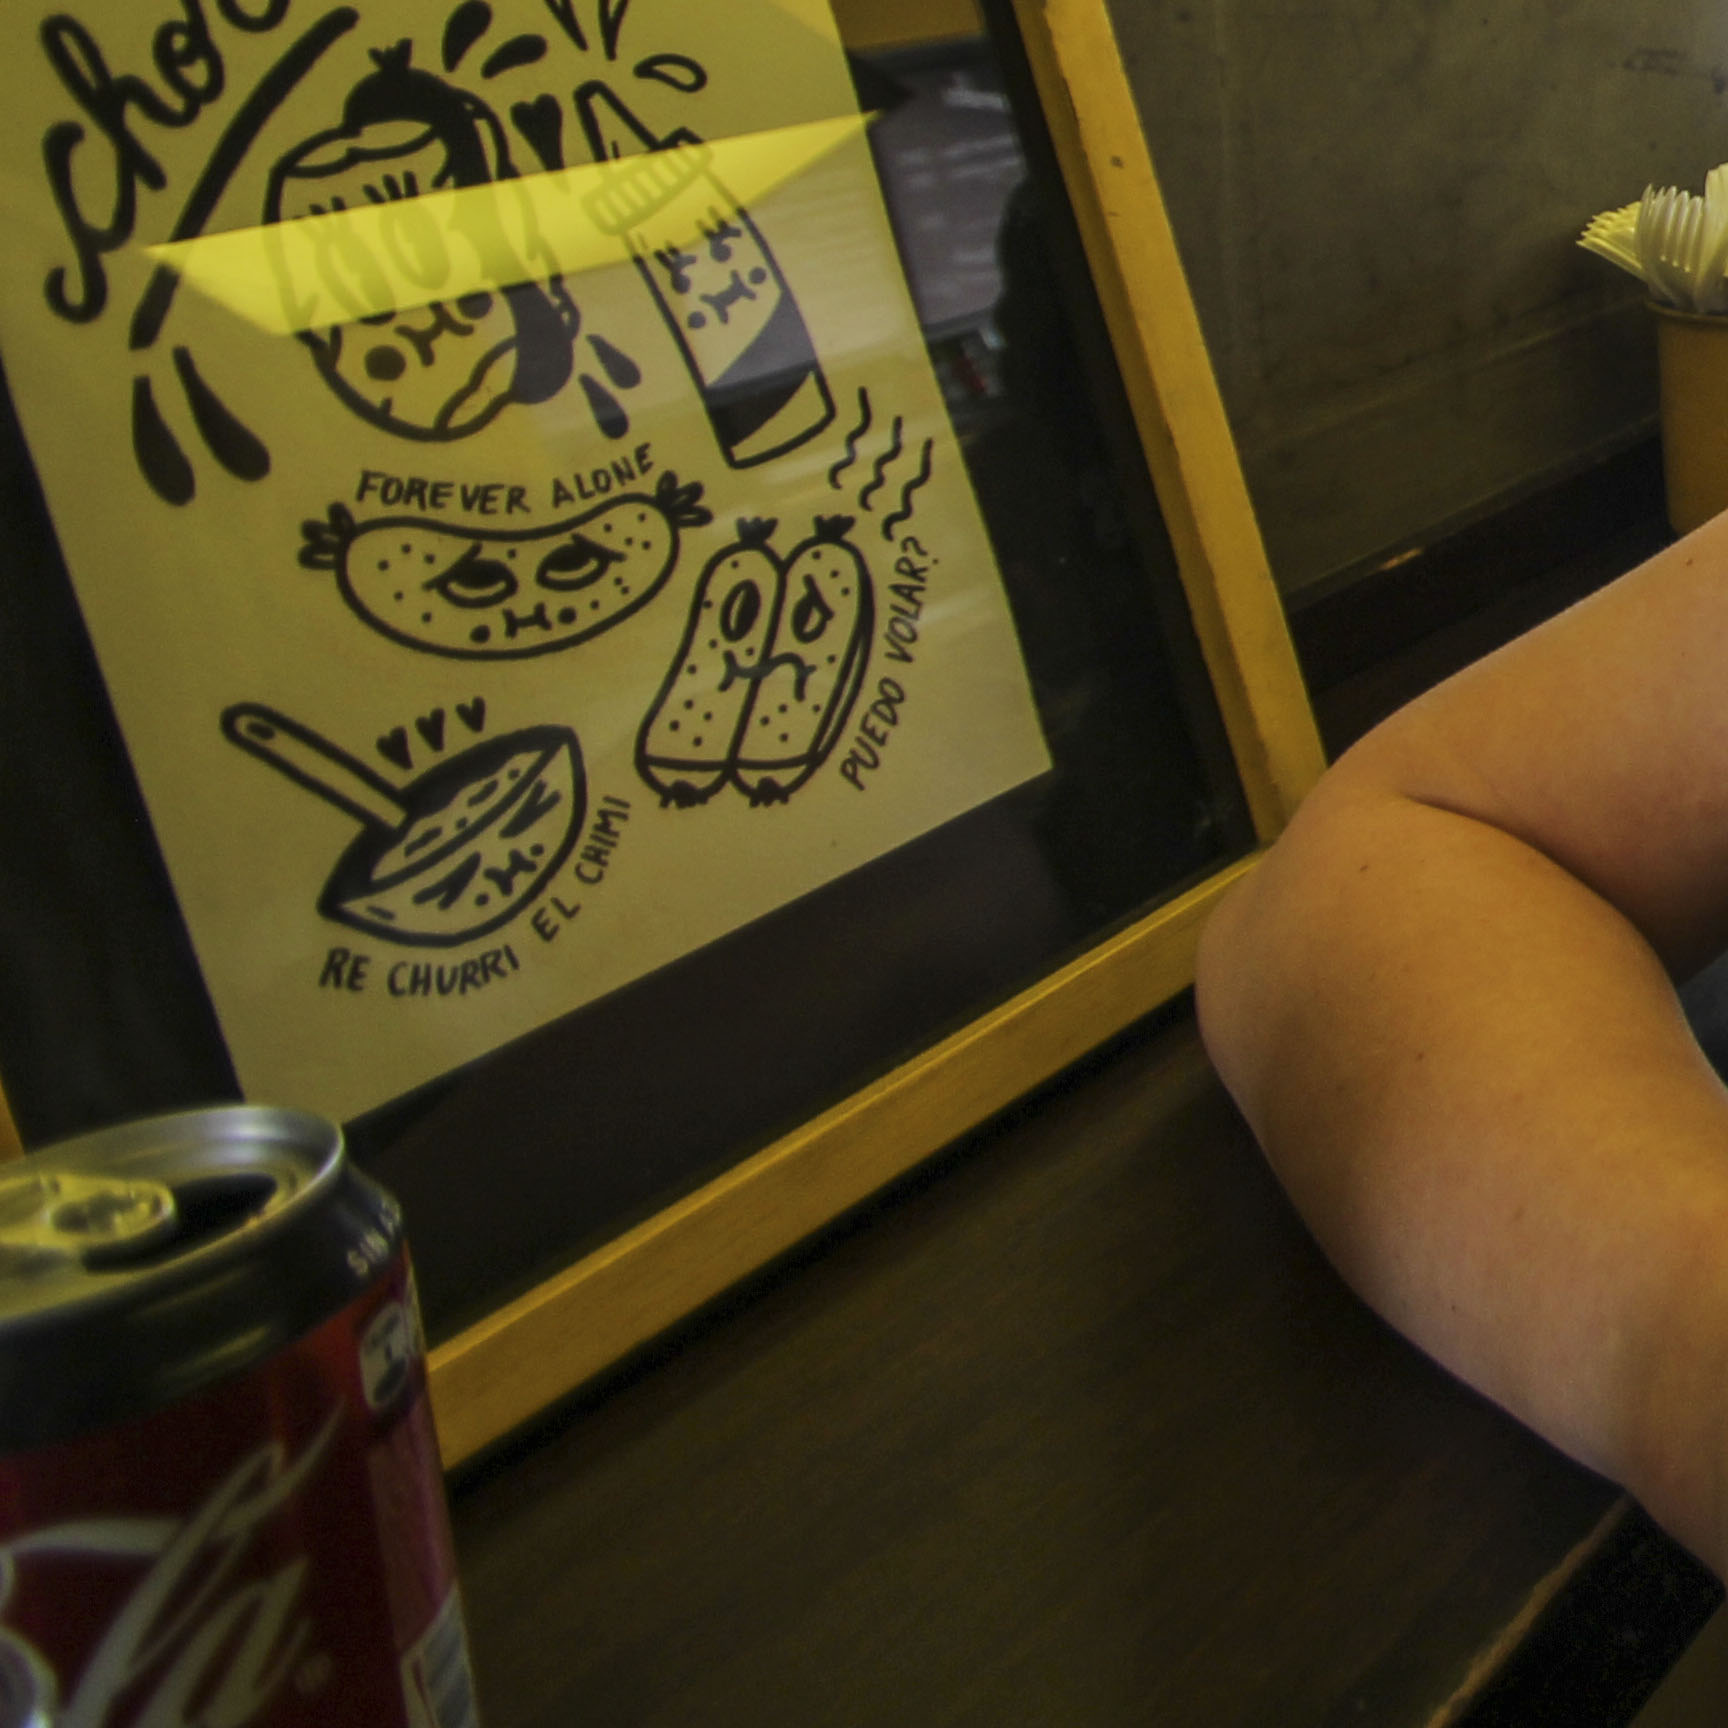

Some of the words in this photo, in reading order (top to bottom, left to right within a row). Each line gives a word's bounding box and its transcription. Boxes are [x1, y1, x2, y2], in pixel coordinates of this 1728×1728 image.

[356, 470, 531, 514] FOREVER
[552, 442, 654, 508] ALONE
[839, 676, 906, 792] PUEDO
[884, 535, 939, 663] VOLAR?
[318, 946, 370, 991] RE
[387, 944, 520, 996] CHURRI
[531, 896, 582, 942] EL
[574, 795, 631, 885] CHIMI
